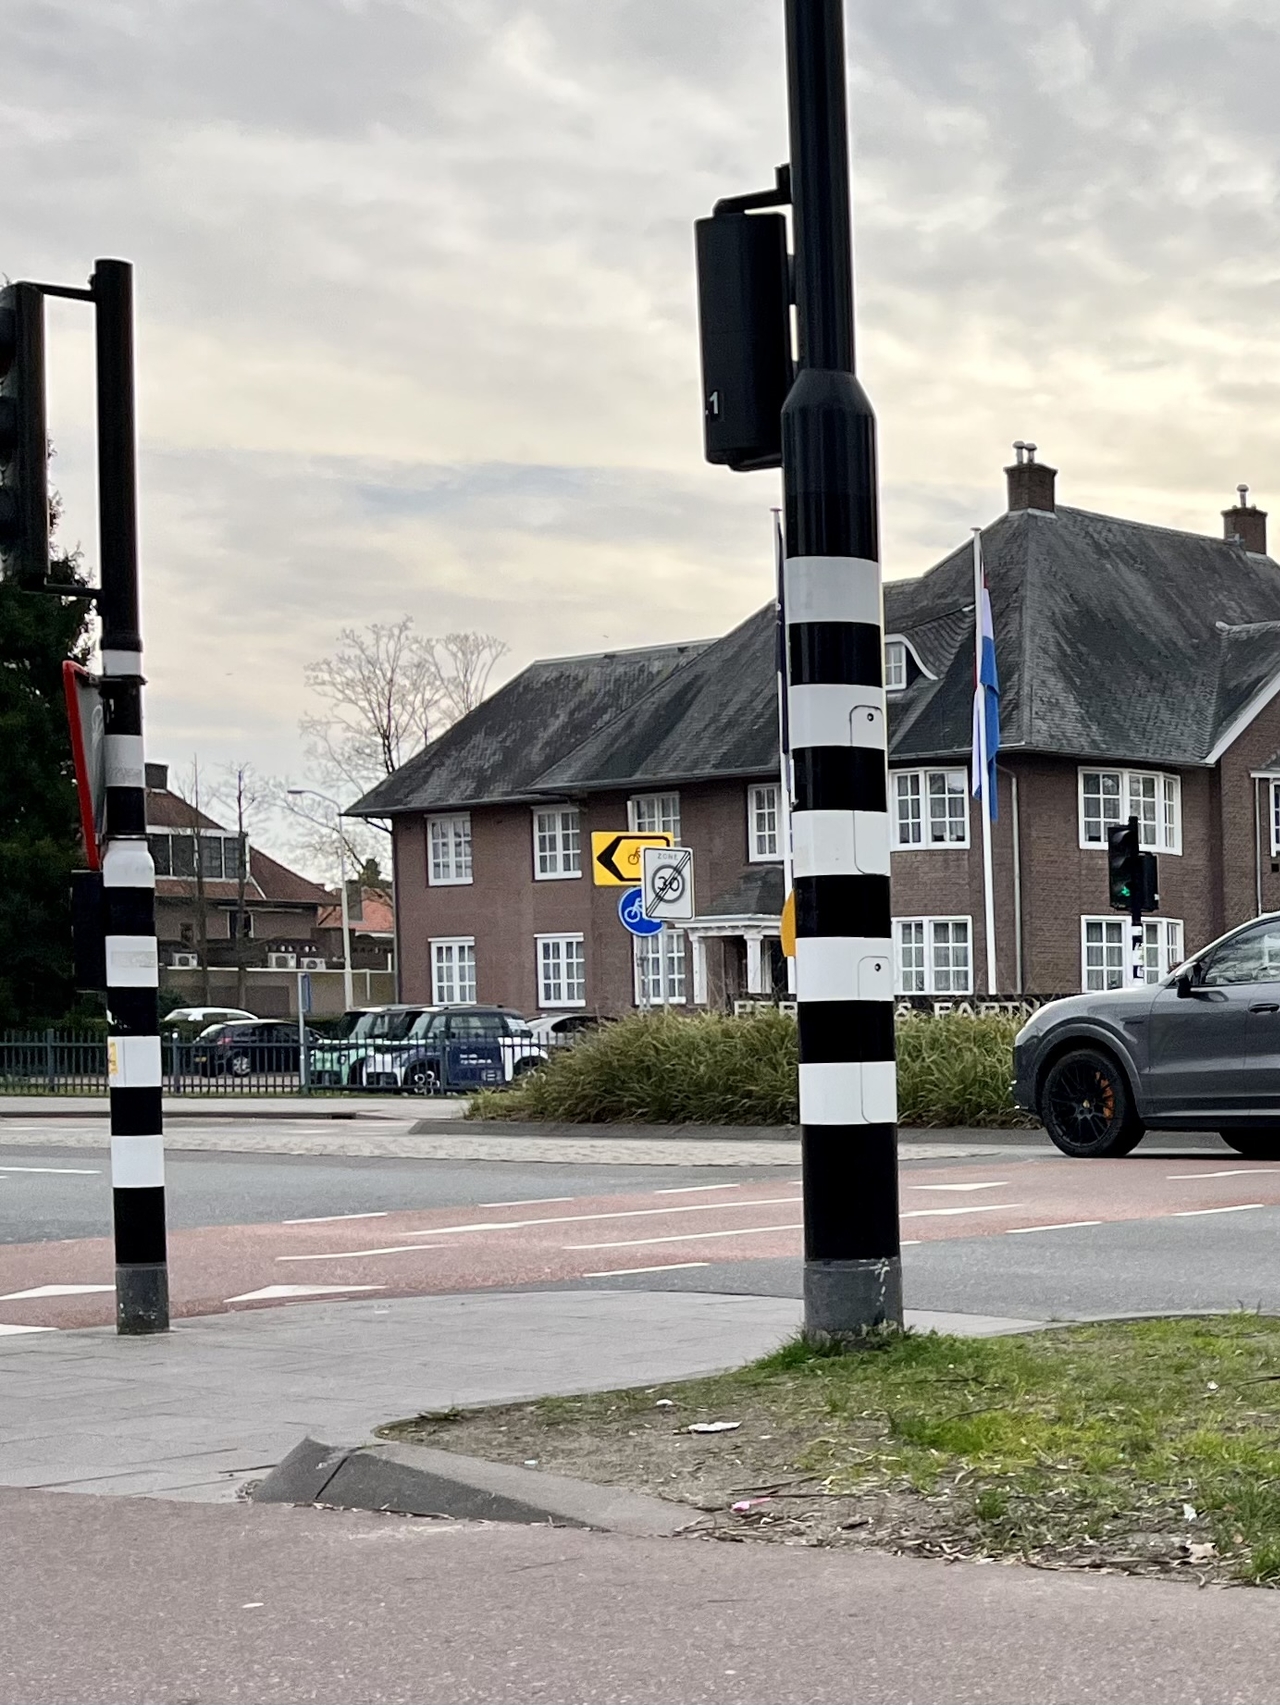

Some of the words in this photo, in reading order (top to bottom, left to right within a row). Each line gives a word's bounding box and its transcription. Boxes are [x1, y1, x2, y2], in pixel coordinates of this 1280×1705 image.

[657, 852, 679, 860] ZONE
[657, 875, 680, 892] 30
[933, 1002, 1041, 1020] PARTN
